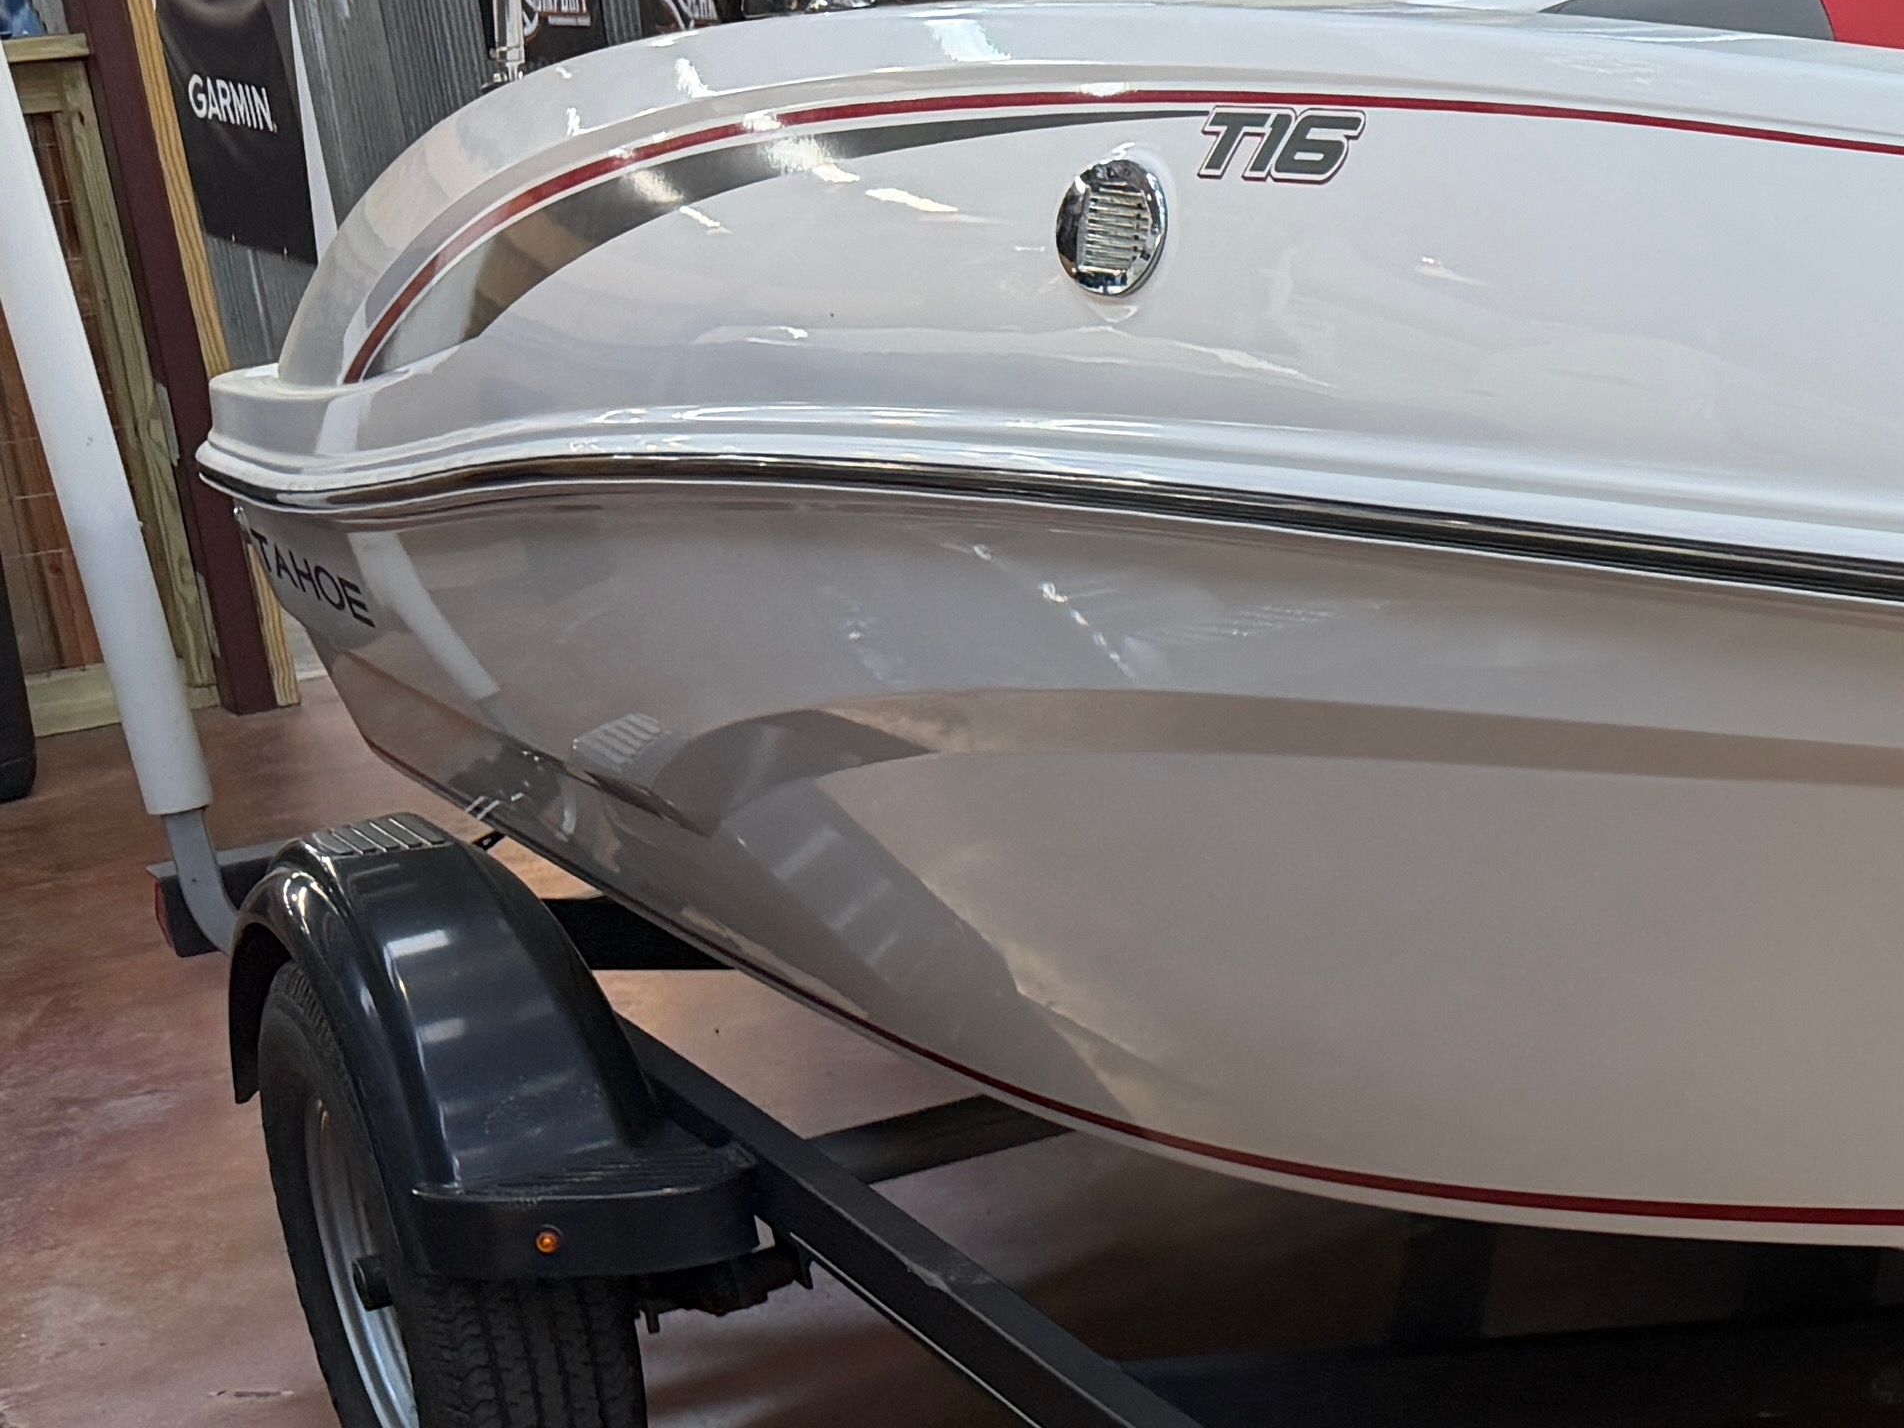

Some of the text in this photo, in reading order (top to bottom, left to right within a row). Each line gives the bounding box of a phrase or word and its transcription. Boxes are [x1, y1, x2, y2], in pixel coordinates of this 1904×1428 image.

[188, 73, 278, 133] GARMIN
[1198, 105, 1366, 184] T16
[251, 530, 376, 628] TAHOE
